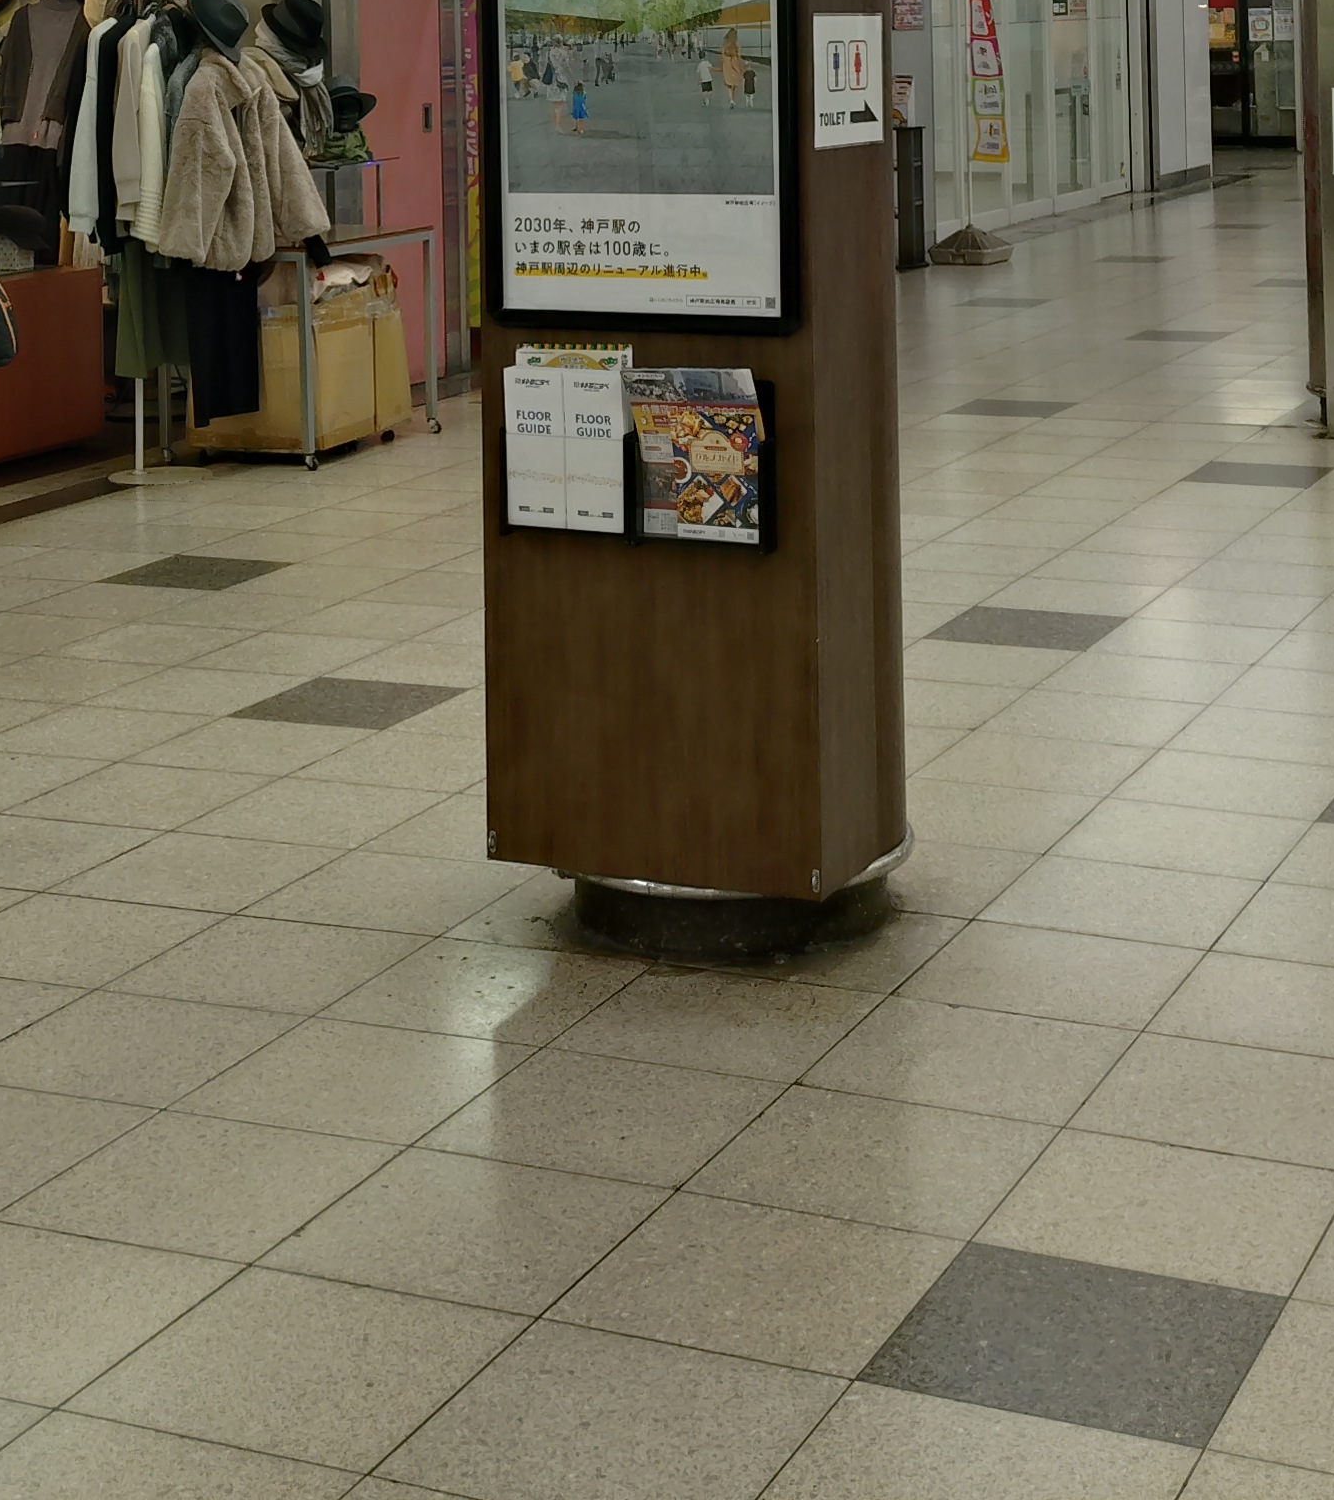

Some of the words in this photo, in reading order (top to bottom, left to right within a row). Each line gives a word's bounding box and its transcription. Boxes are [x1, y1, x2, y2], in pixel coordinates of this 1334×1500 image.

[819, 111, 846, 126] TOILET
[514, 217, 641, 235] 2030年、神戸駅の
[514, 240, 670, 257] いまの駅舎は100歳に。
[515, 262, 708, 279] 神戸駅周辺のリニューアル進行中。
[516, 410, 552, 422] FLOOR
[575, 414, 611, 426] FLOOR
[517, 423, 552, 435] GUIDE
[576, 427, 611, 438] GUIDE
